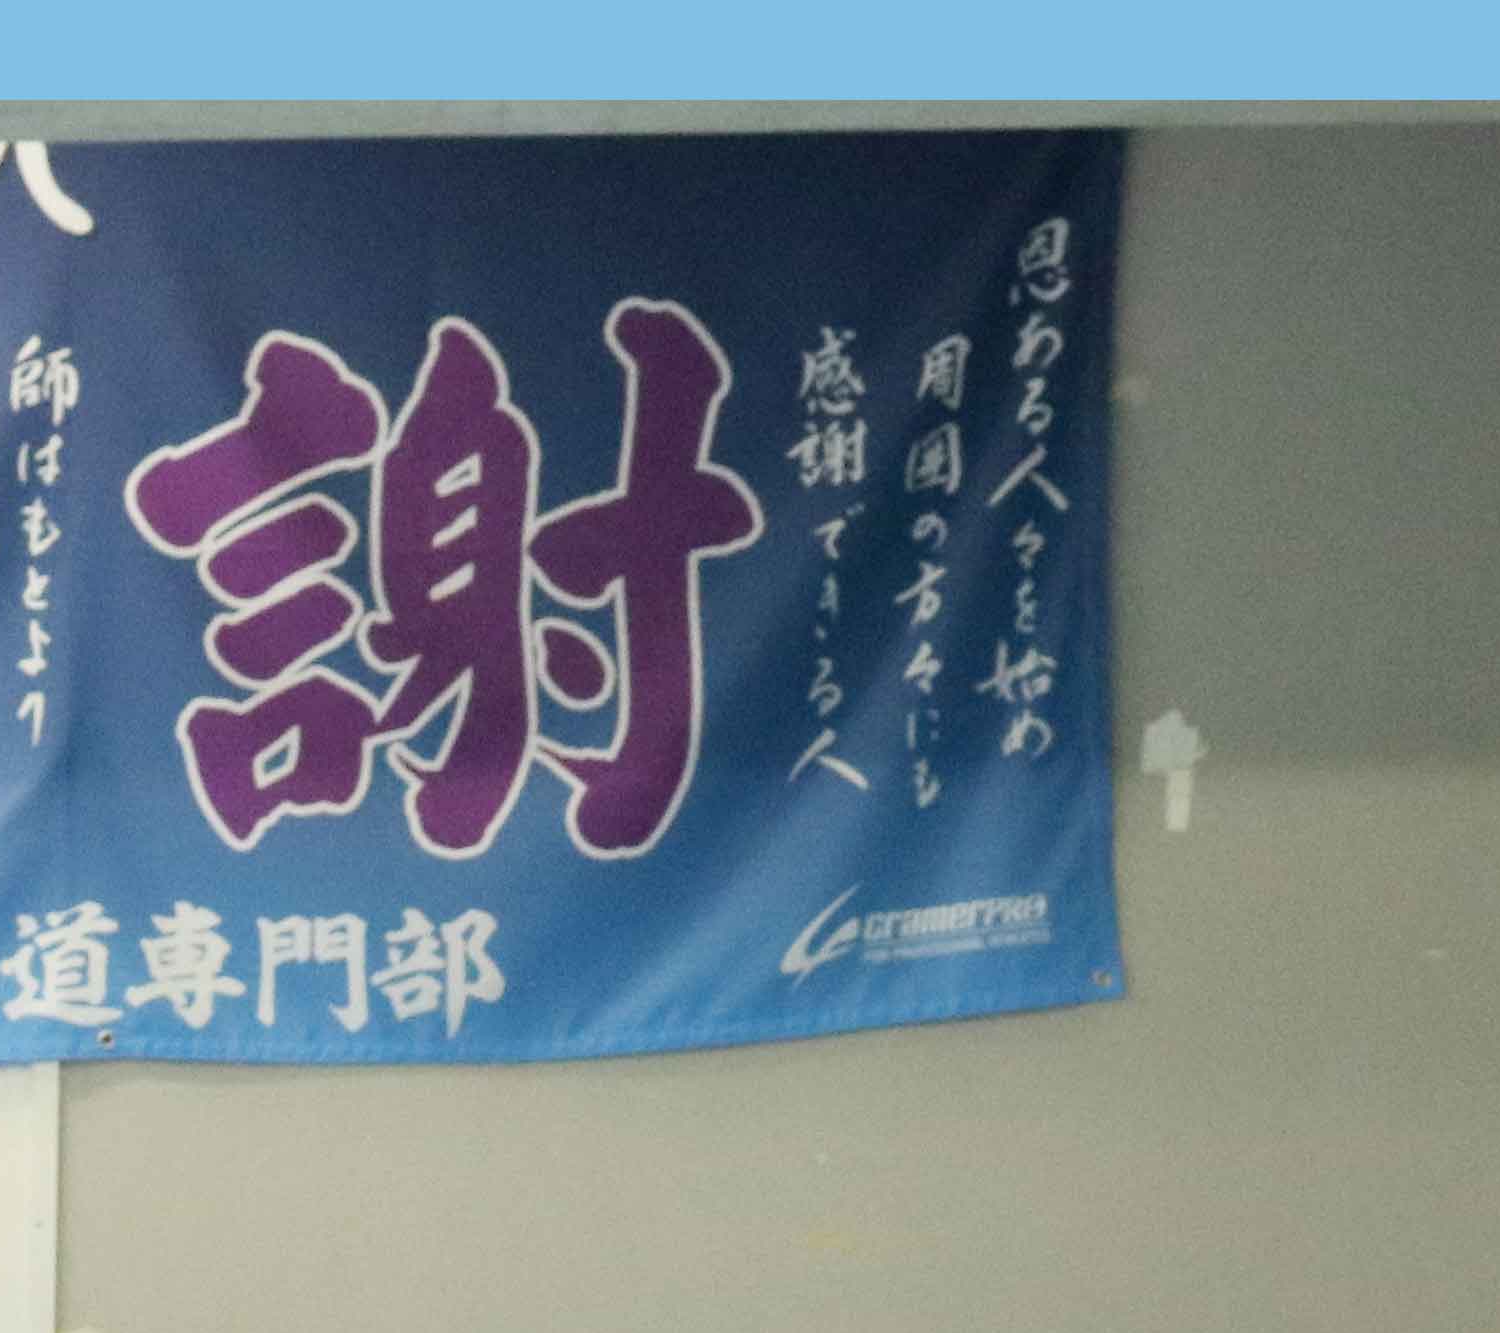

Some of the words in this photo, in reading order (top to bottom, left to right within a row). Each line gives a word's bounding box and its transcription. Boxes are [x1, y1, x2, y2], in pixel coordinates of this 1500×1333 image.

[8, 334, 80, 748] 師はもとより
[124, 296, 765, 860] 謝
[786, 325, 869, 793] 感謝できる人
[894, 332, 972, 810] 周囲の方々にも
[974, 216, 1072, 762] 恩ある人々を始め
